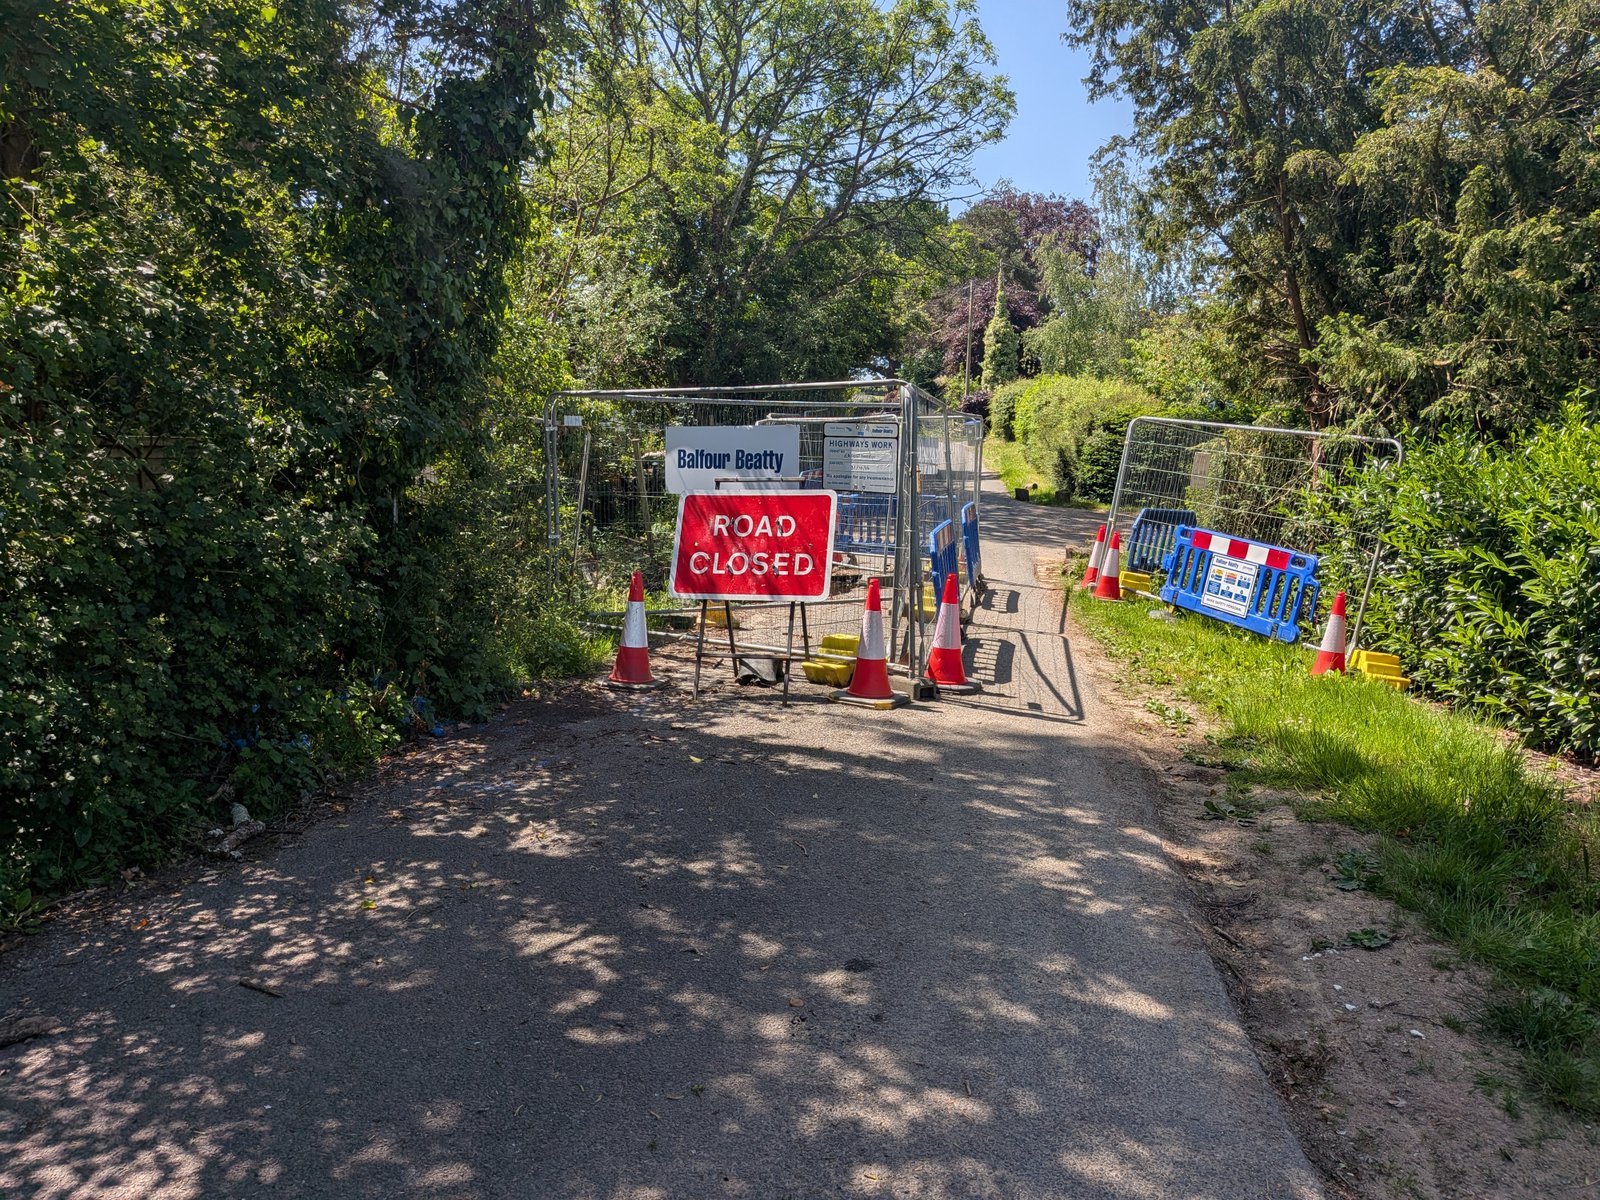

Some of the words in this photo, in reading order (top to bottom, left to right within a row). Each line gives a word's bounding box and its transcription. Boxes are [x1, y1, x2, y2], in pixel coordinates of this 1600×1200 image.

[829, 440, 869, 448] HIGHWAYS
[871, 440, 893, 449] WORK
[677, 449, 731, 470] Balfour
[735, 449, 784, 473] Beatty
[713, 514, 796, 538] ROAD
[689, 551, 814, 577] CLOSED
